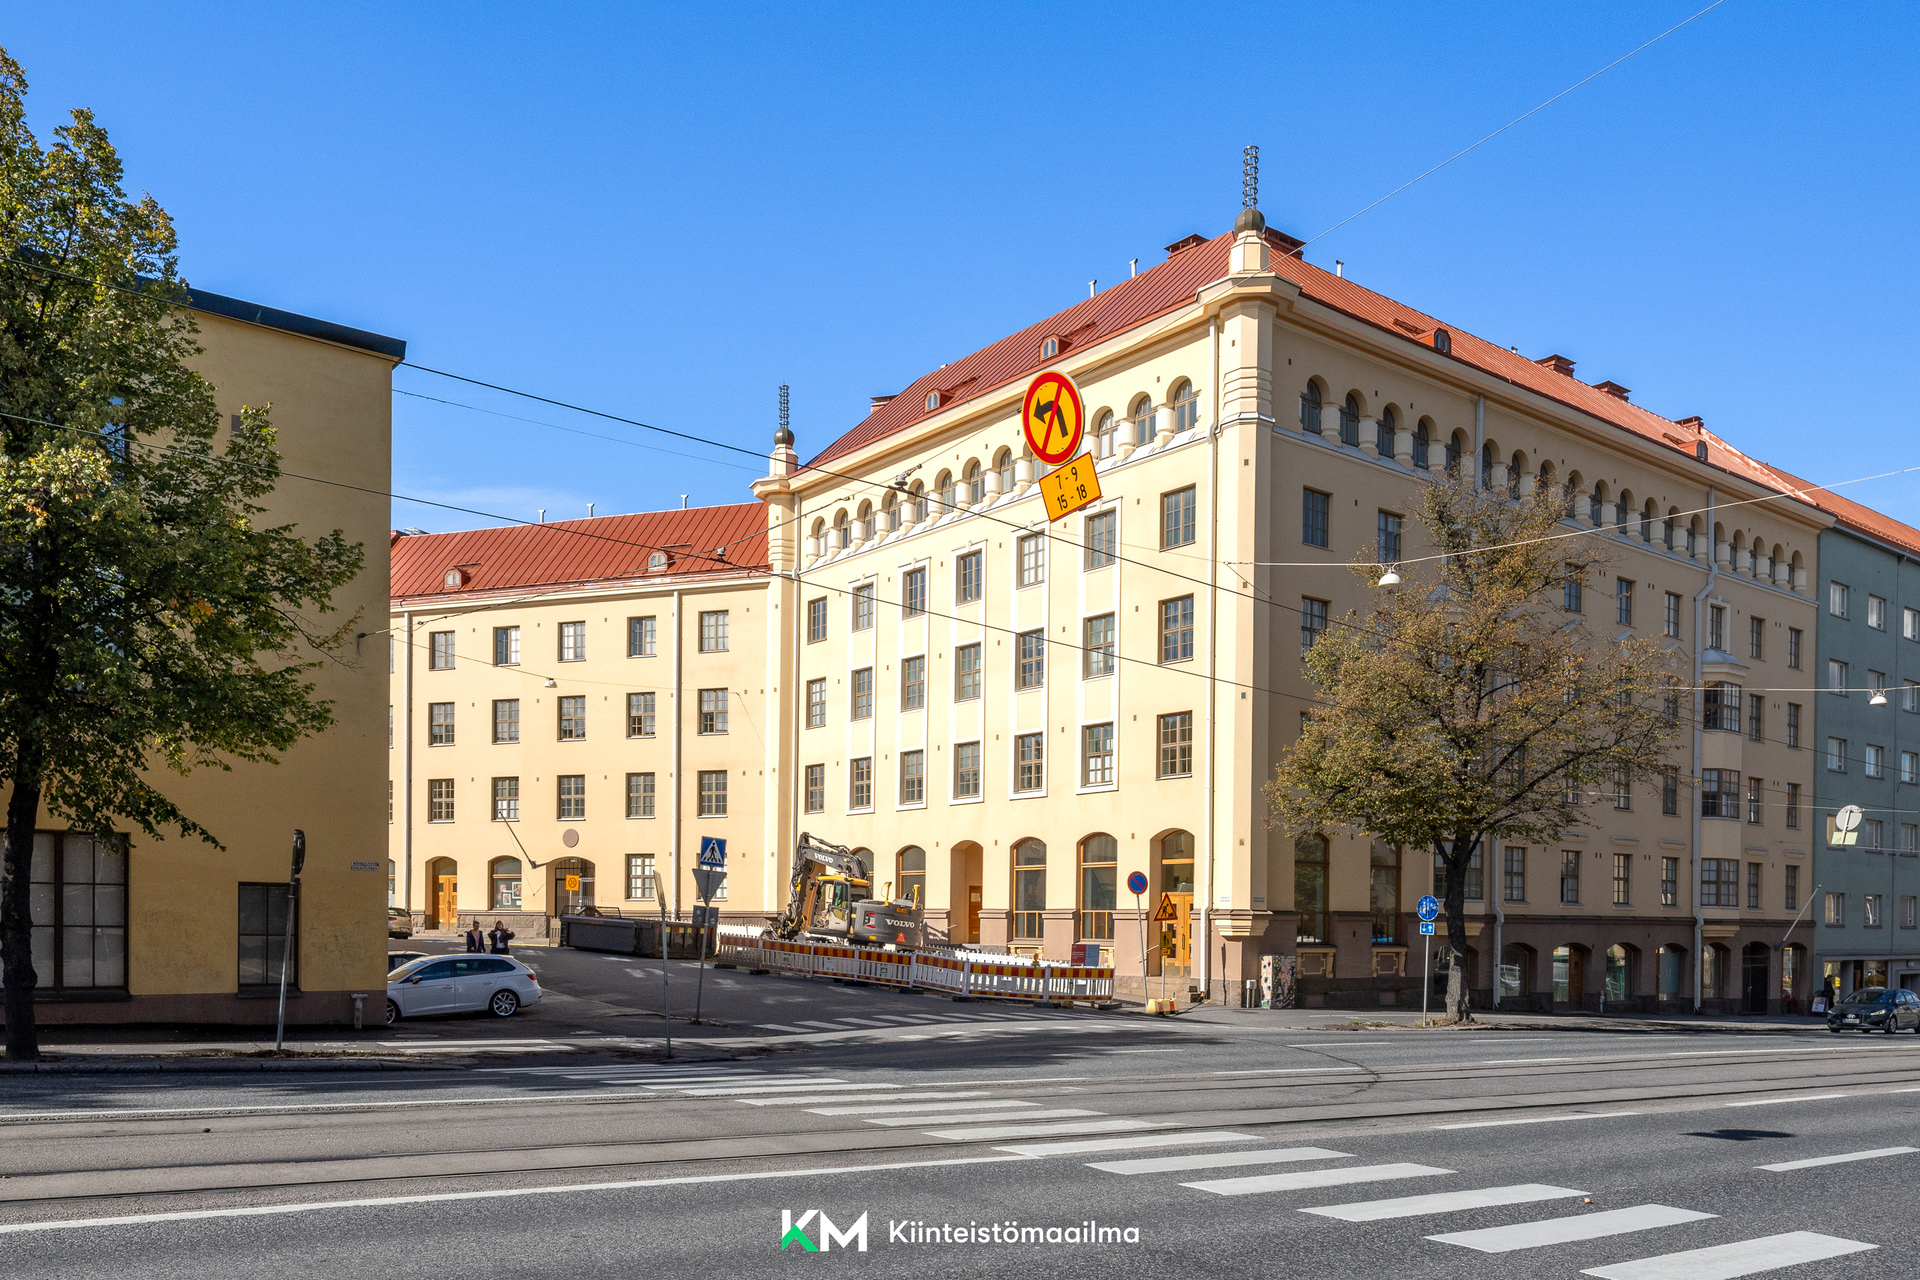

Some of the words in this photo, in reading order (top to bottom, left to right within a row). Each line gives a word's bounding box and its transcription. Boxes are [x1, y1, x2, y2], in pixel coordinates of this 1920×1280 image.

[1055, 474, 1063, 490] 7
[1071, 466, 1078, 482] 9
[1057, 494, 1068, 511] 15
[1076, 484, 1088, 501] 18
[814, 852, 834, 863] VOLVO
[885, 918, 915, 928] VOLVO
